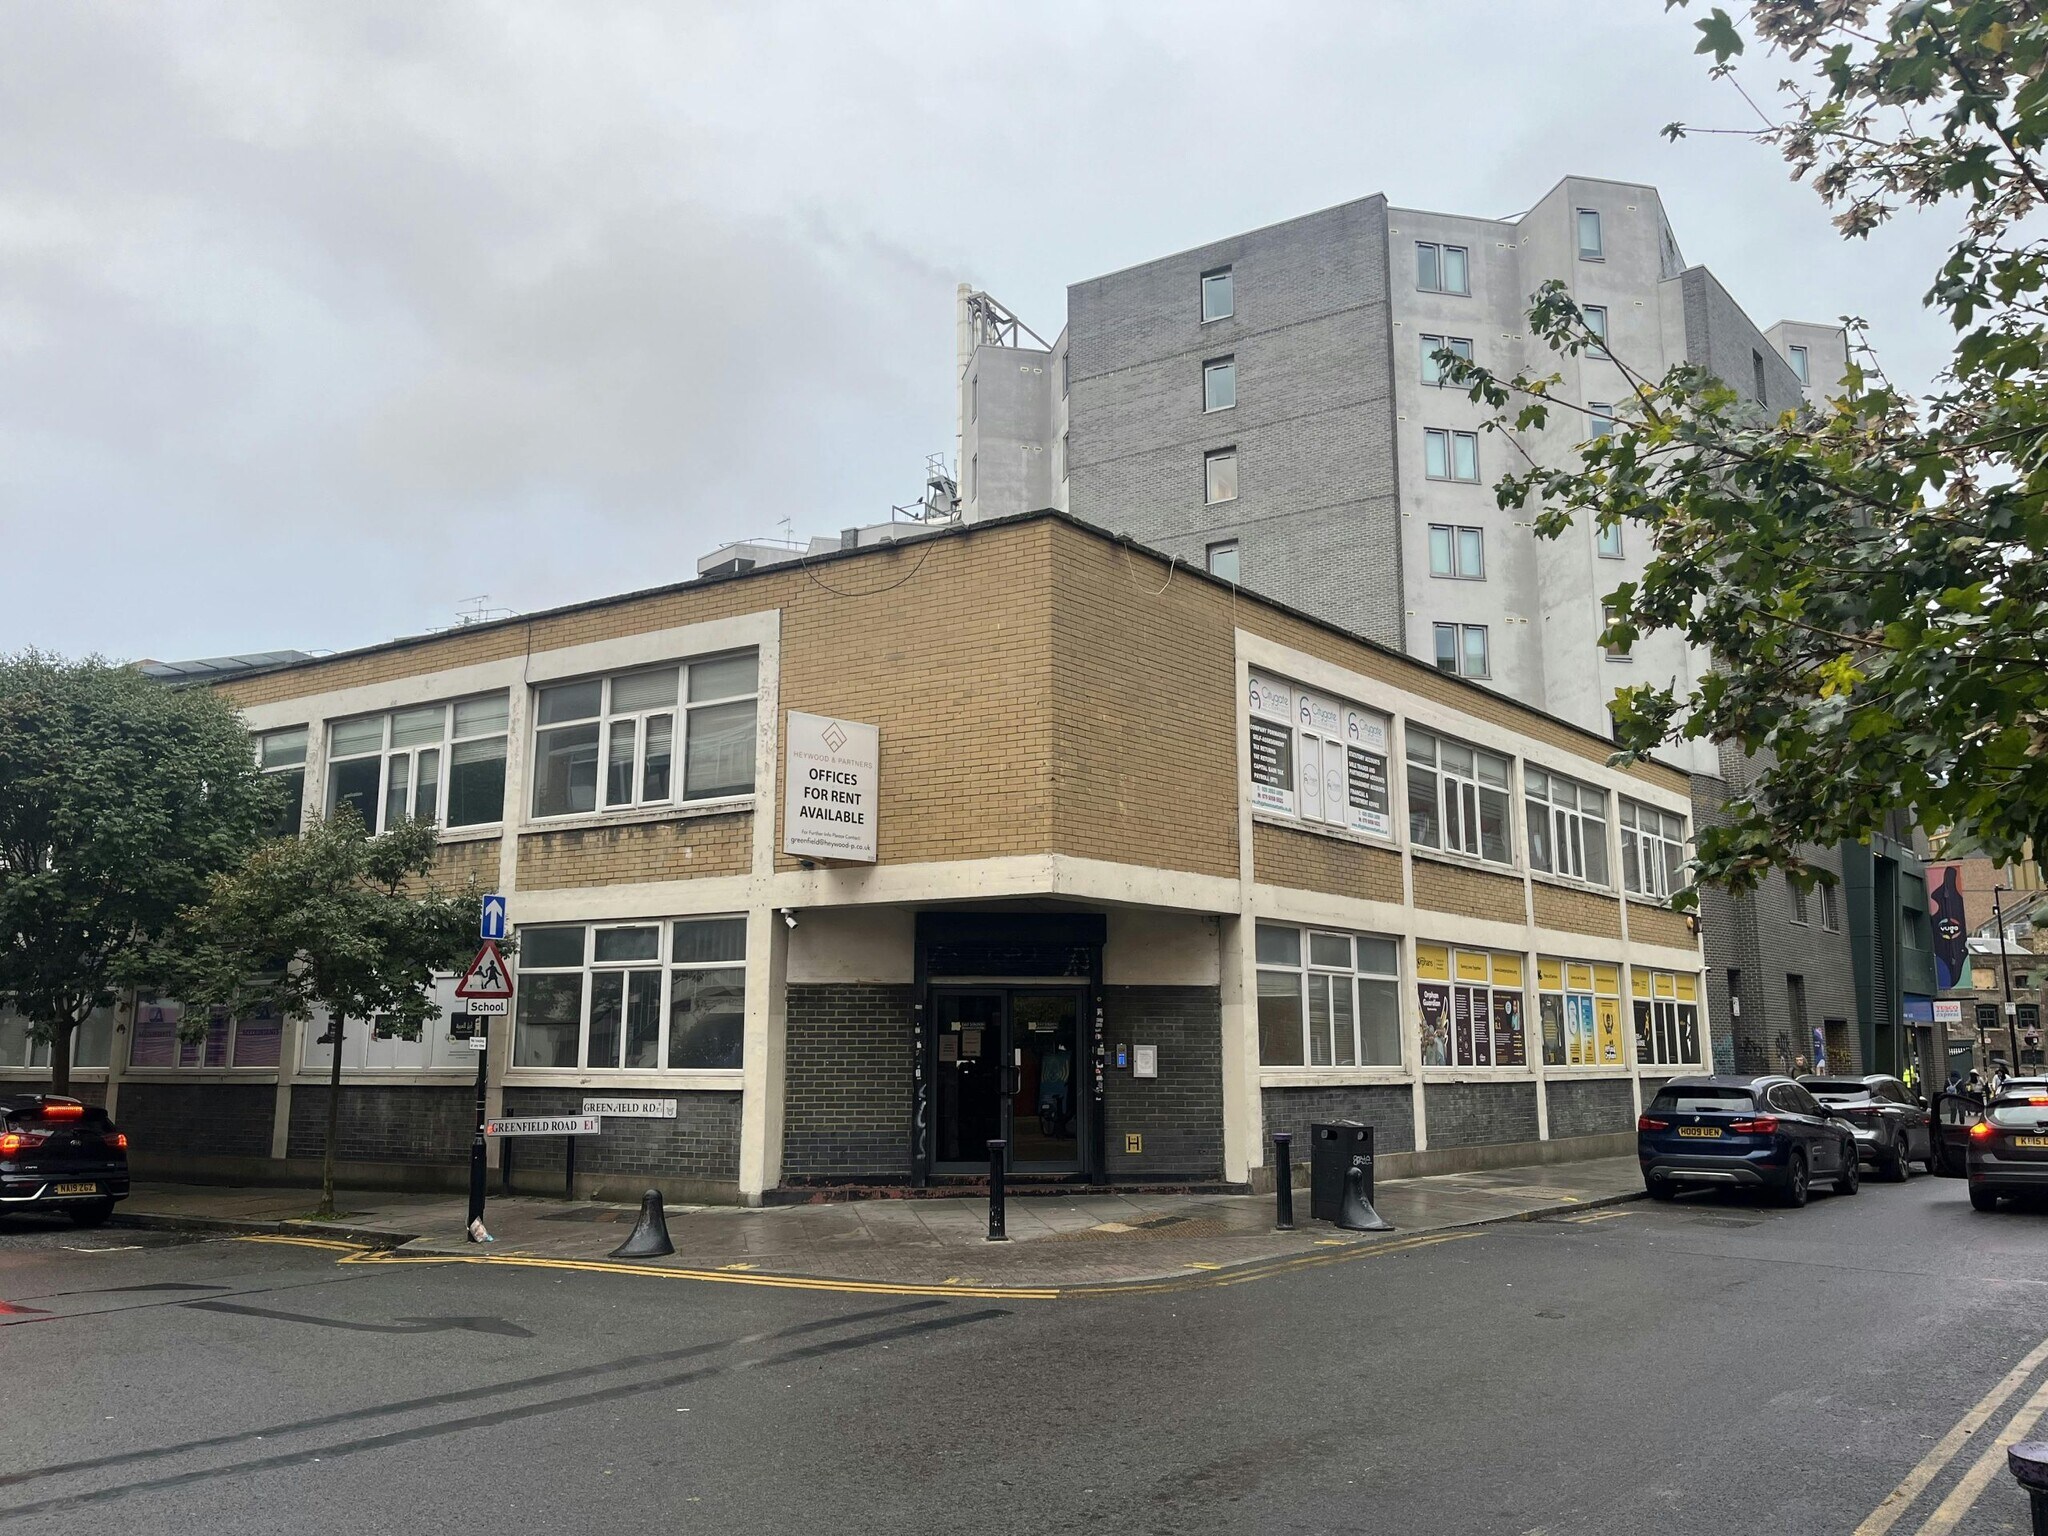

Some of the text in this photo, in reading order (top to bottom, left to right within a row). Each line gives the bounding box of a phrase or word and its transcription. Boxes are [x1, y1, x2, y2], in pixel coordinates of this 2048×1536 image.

[793, 751, 829, 762] HEYWOOD
[838, 758, 873, 769] PARTNERS
[809, 768, 857, 786] OFFICES
[804, 786, 862, 805] FOR RENT
[800, 805, 864, 825] AVAILABLE
[471, 1002, 504, 1011] School
[642, 1103, 656, 1112] RD
[492, 1120, 593, 1132] GREENFIELD ROAD E1
[1703, 1128, 1719, 1136] UEN
[1128, 1136, 1139, 1151] H
[60, 1184, 78, 1193] NA19
